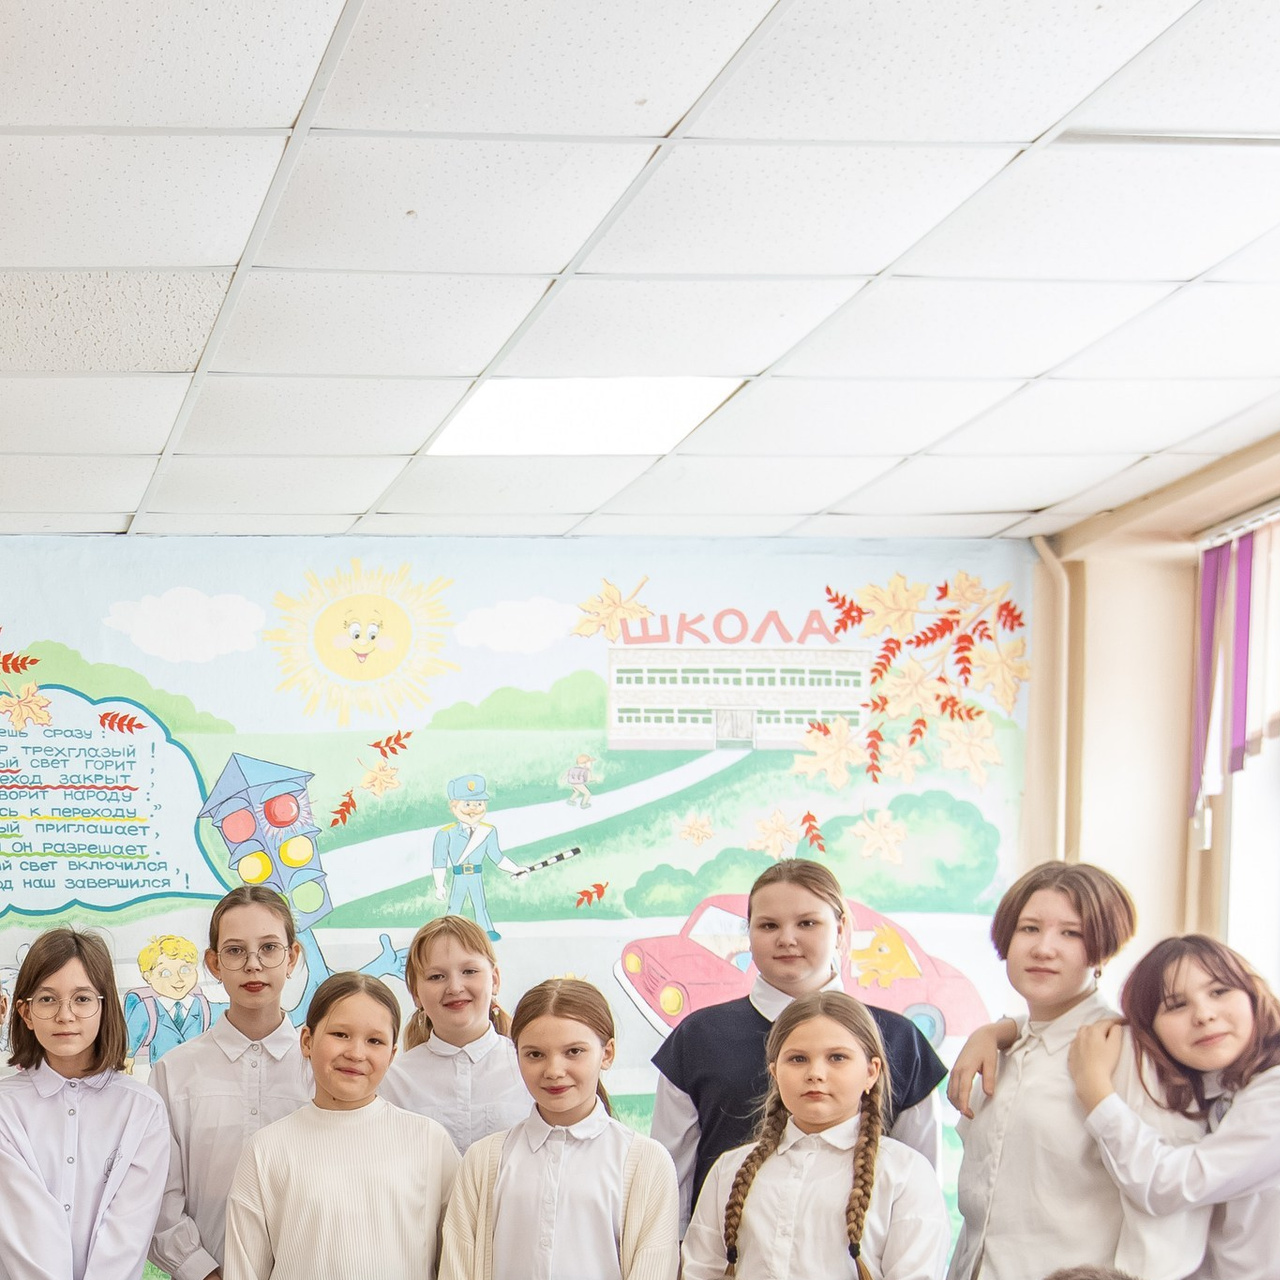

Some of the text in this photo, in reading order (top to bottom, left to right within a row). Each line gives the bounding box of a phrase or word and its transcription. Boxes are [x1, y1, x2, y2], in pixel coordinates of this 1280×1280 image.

[620, 607, 841, 645] ШКОЛА
[30, 758, 70, 769] свет
[30, 807, 41, 817] к
[35, 823, 159, 838] приглашает,
[11, 841, 33, 853] он
[19, 860, 58, 871] свет
[23, 878, 56, 889] наш
